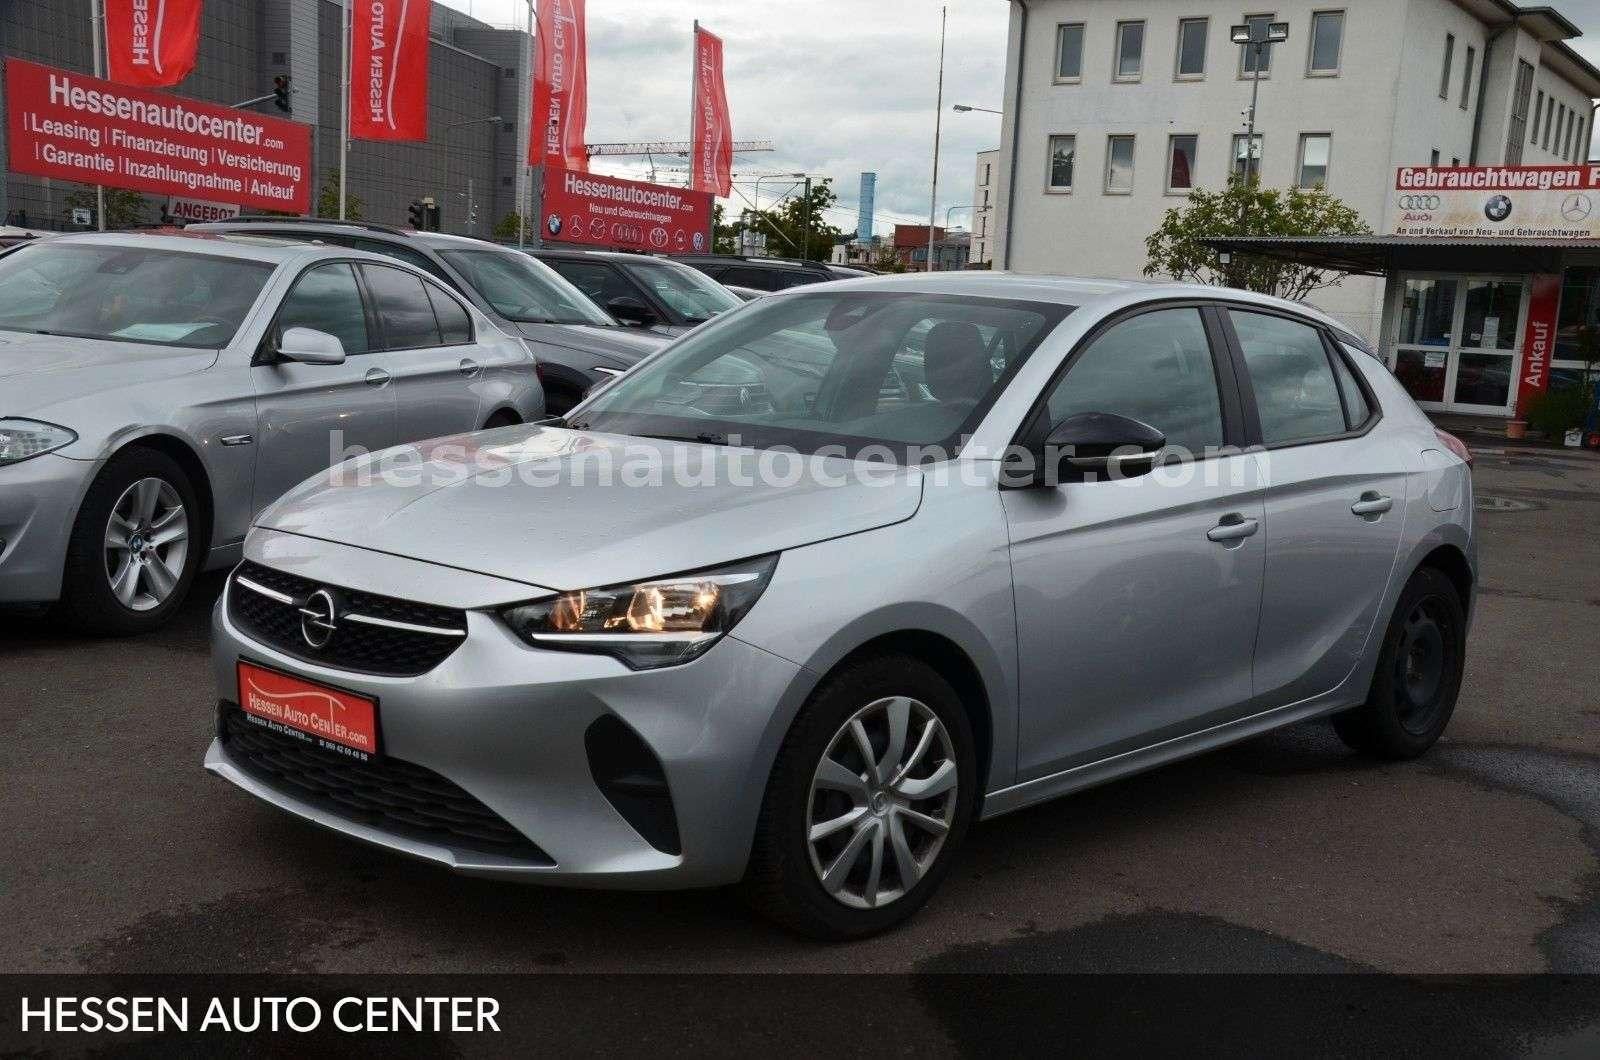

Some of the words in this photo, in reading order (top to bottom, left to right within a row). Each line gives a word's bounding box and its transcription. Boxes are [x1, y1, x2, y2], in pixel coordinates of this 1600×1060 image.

[31, 112, 100, 147] Leasing
[112, 128, 208, 167] Finanzierung
[218, 148, 301, 182] Versicherung
[43, 143, 115, 172] Garantie
[125, 157, 242, 193] Inzahlungnahme
[250, 179, 295, 200] Ankauf
[1400, 167, 1581, 189] Gebrauchtwagen
[604, 206, 618, 216] und
[1402, 213, 1433, 222] Audi
[1396, 226, 1407, 235] An
[1409, 227, 1424, 235] und
[1425, 227, 1457, 236] Verkauf
[1499, 228, 1514, 236] und
[1516, 228, 1590, 237] Gebrauchtwagen
[1525, 320, 1548, 388] Ankauf
[248, 693, 283, 717] HESSEN
[283, 704, 309, 726] AUTO
[246, 713, 267, 726] HESSEN
[267, 721, 283, 732] AUTO
